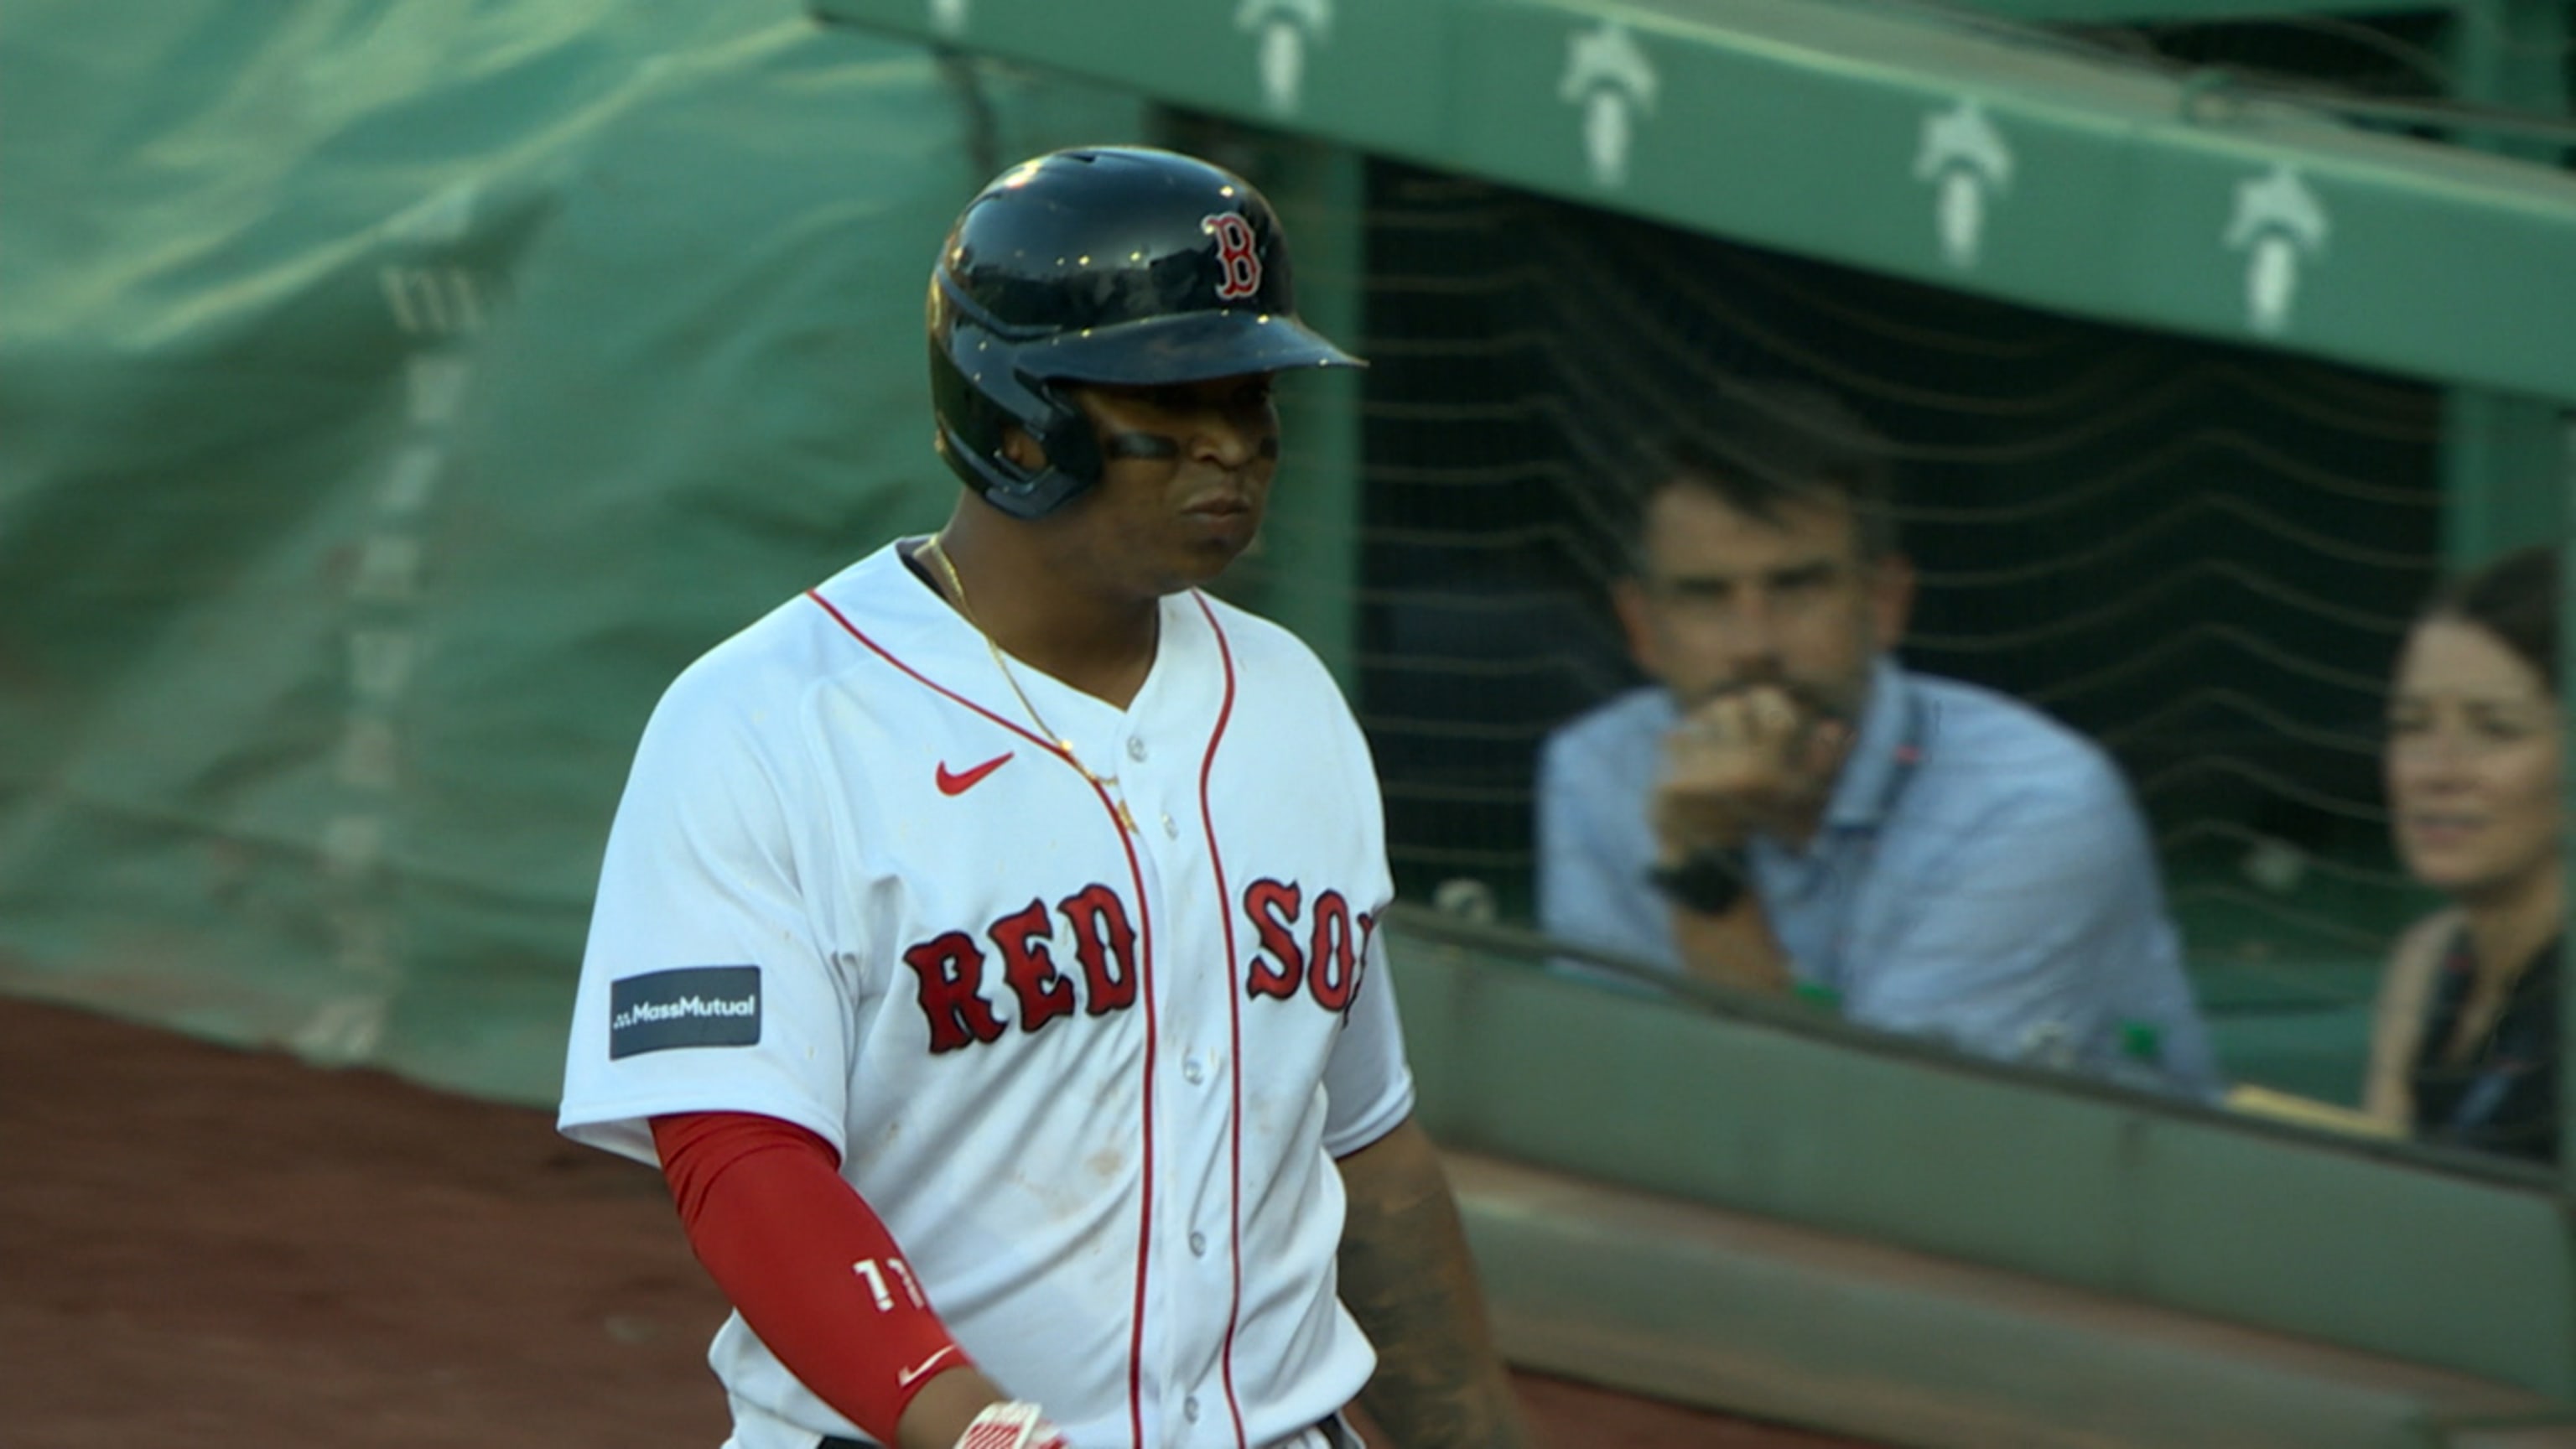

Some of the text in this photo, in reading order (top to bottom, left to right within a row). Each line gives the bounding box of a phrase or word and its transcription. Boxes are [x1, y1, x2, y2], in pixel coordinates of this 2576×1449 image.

[1200, 211, 1262, 300] B
[631, 995, 755, 1025] MassMutual
[902, 878, 1374, 1055] RED SO
